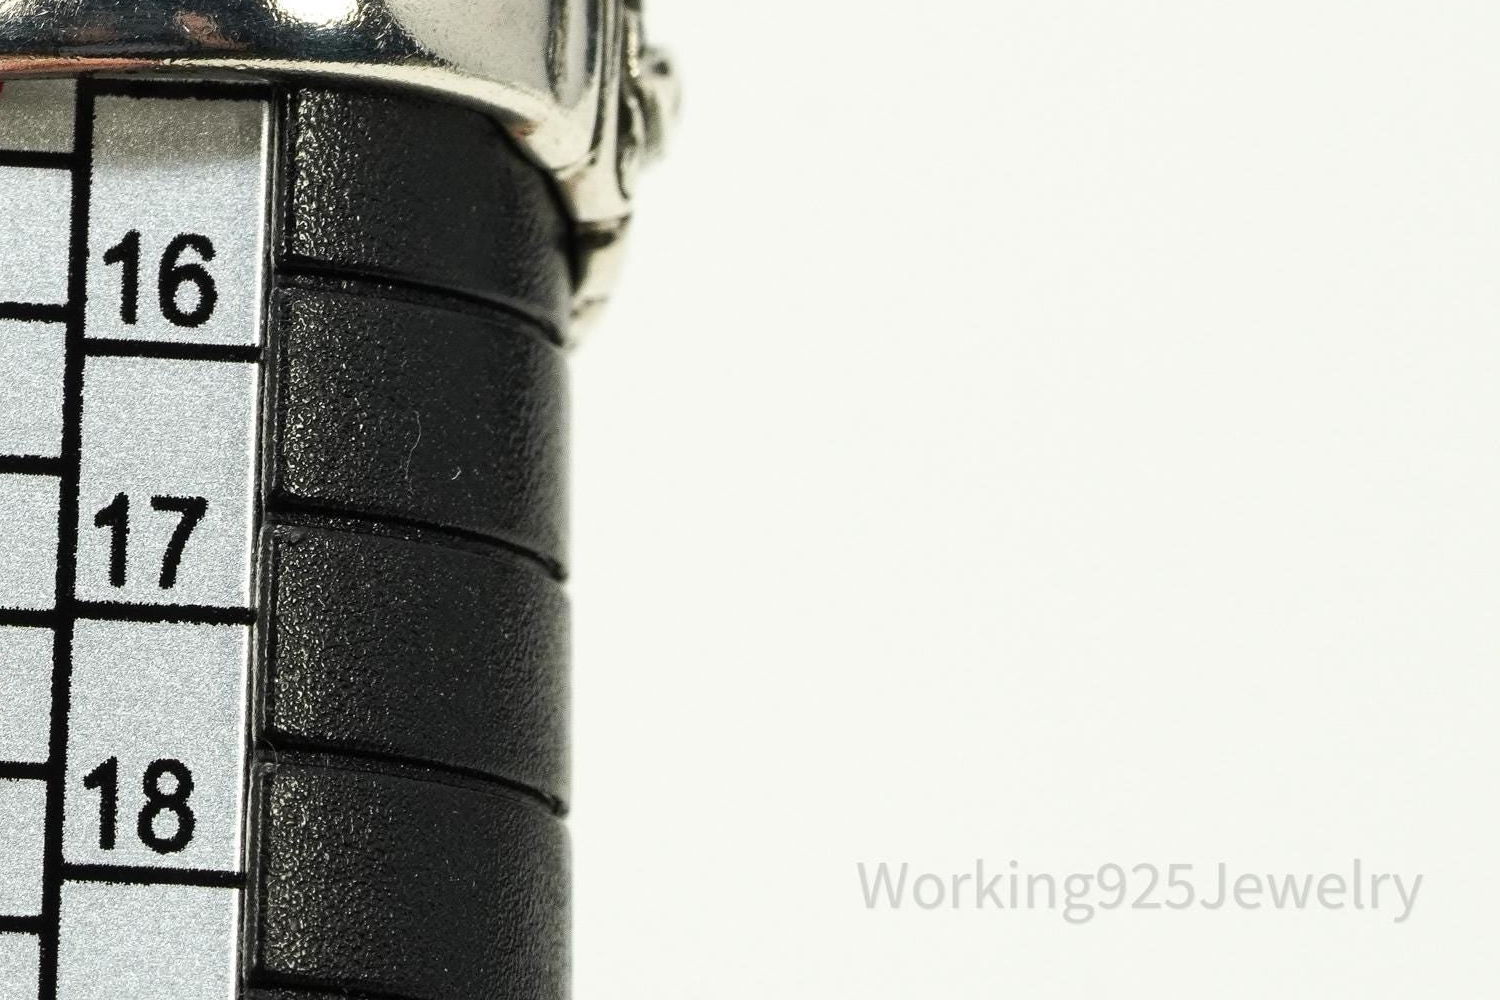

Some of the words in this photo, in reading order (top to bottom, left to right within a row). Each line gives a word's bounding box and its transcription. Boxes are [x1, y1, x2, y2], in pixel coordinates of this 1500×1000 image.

[102, 228, 220, 330] 16
[93, 491, 211, 591] 17
[82, 755, 199, 857] 18
